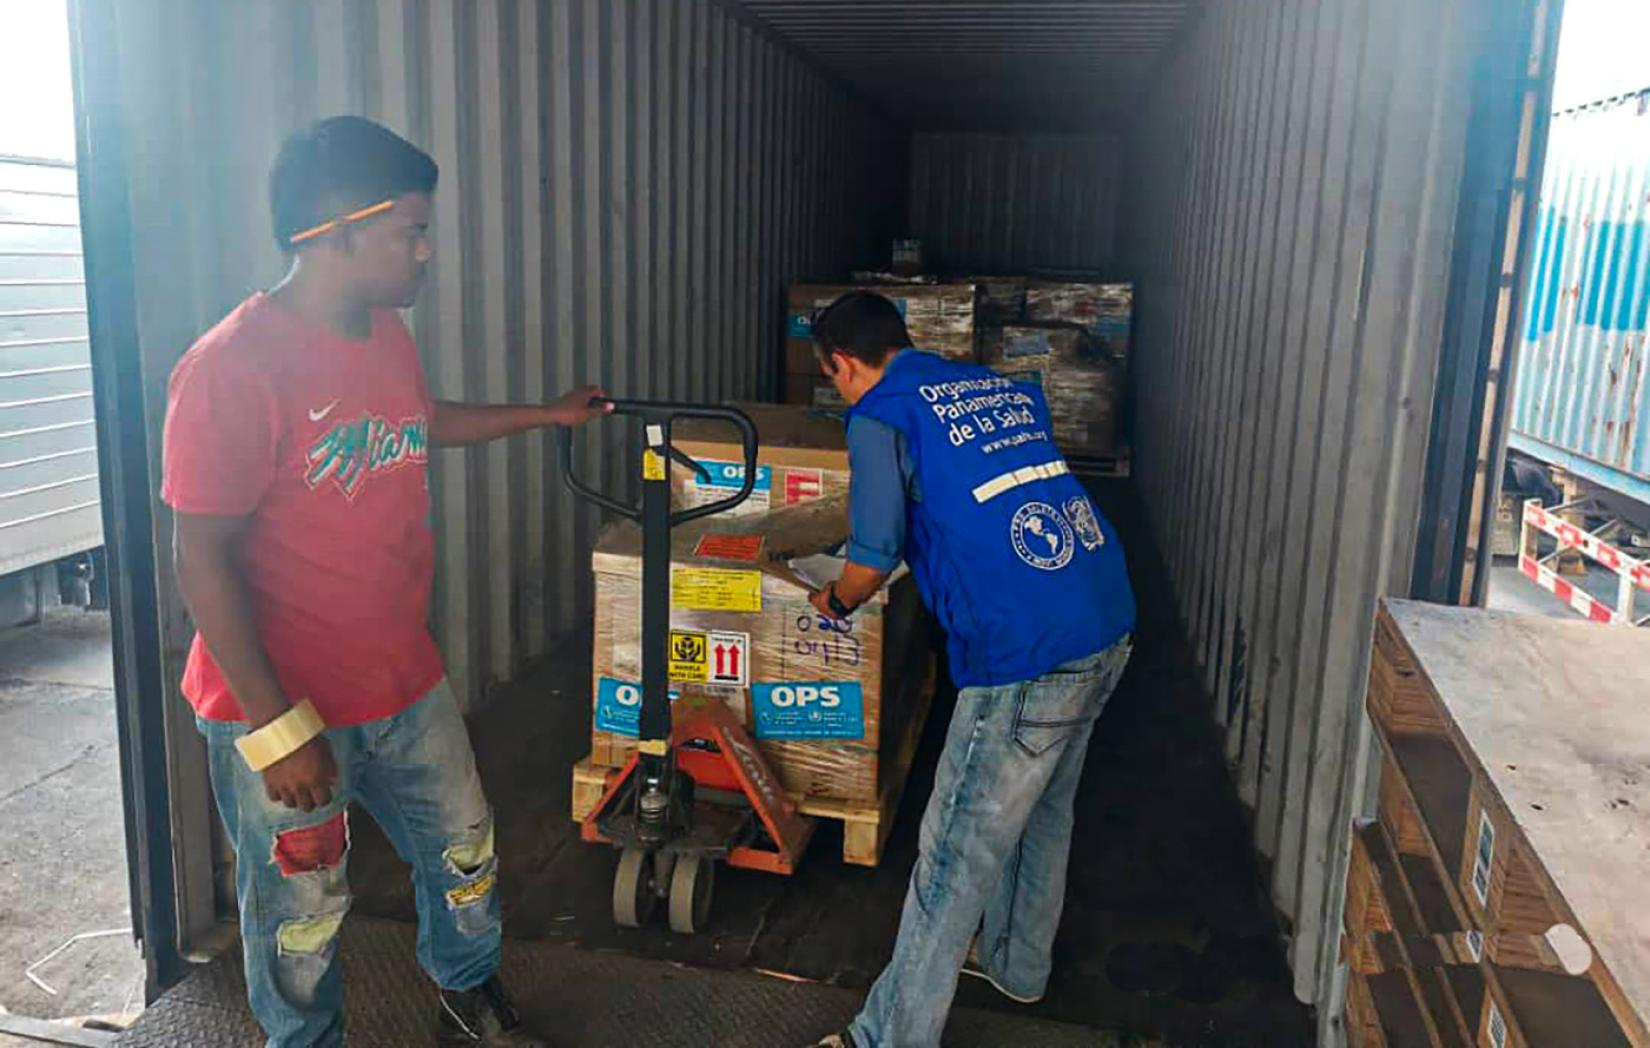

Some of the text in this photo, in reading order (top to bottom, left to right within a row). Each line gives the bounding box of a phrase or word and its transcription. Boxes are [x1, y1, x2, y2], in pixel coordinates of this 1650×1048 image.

[949, 405, 1035, 447] de la Salud
[771, 686, 841, 708] OPS
